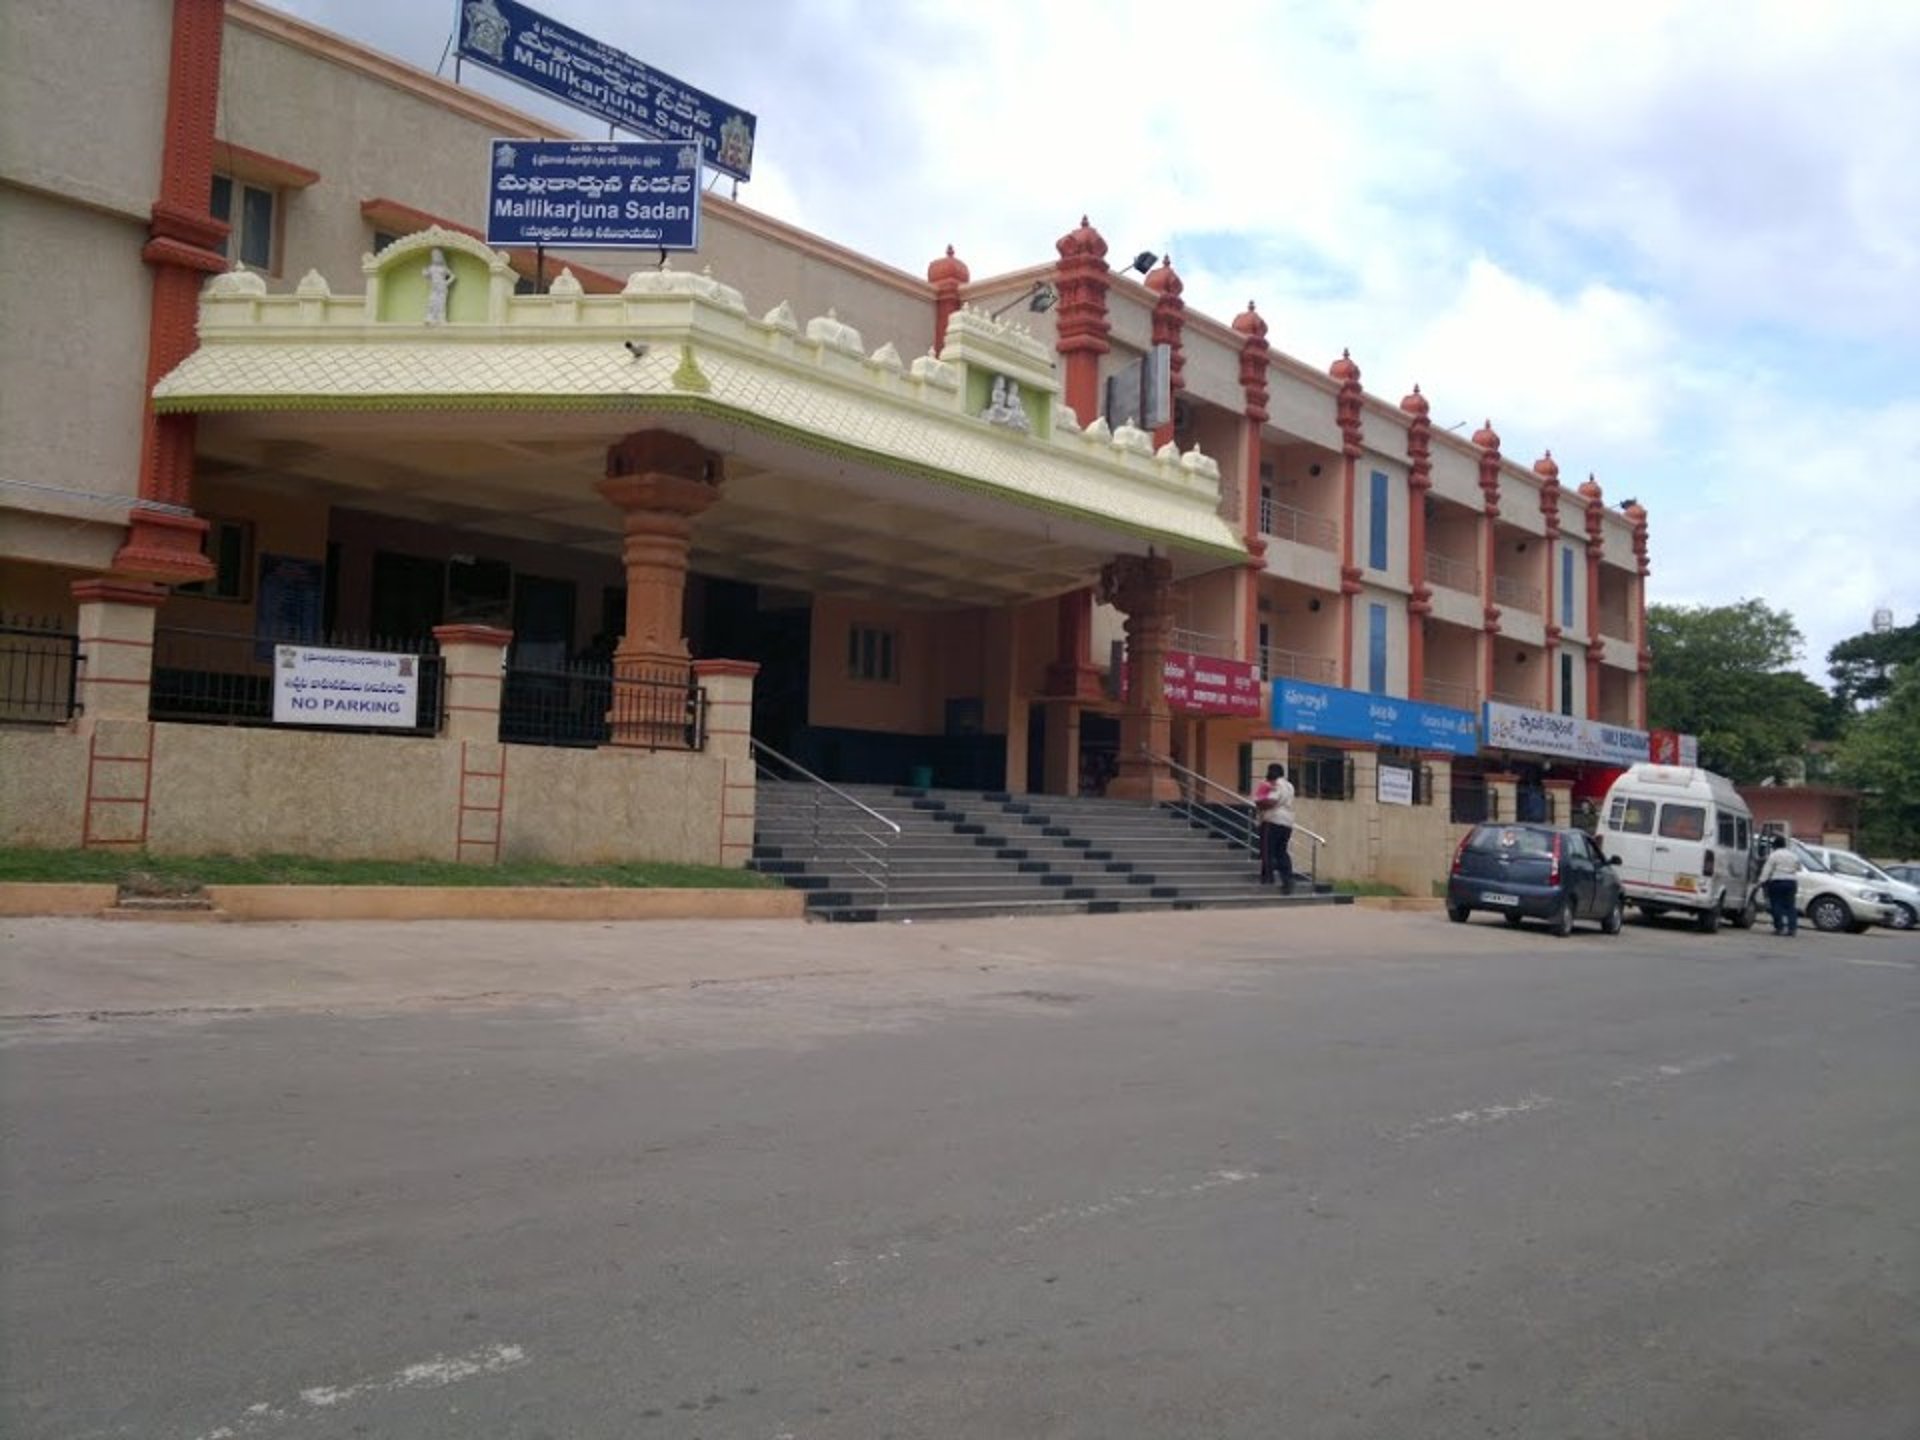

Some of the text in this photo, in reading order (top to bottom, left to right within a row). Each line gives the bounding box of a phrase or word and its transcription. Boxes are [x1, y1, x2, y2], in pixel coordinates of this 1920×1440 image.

[513, 45, 648, 119] Mallikarjuna
[655, 109, 717, 151] Sadan
[495, 198, 690, 222] Mallikarjuna Sadan
[291, 697, 400, 714] NO PARKING
